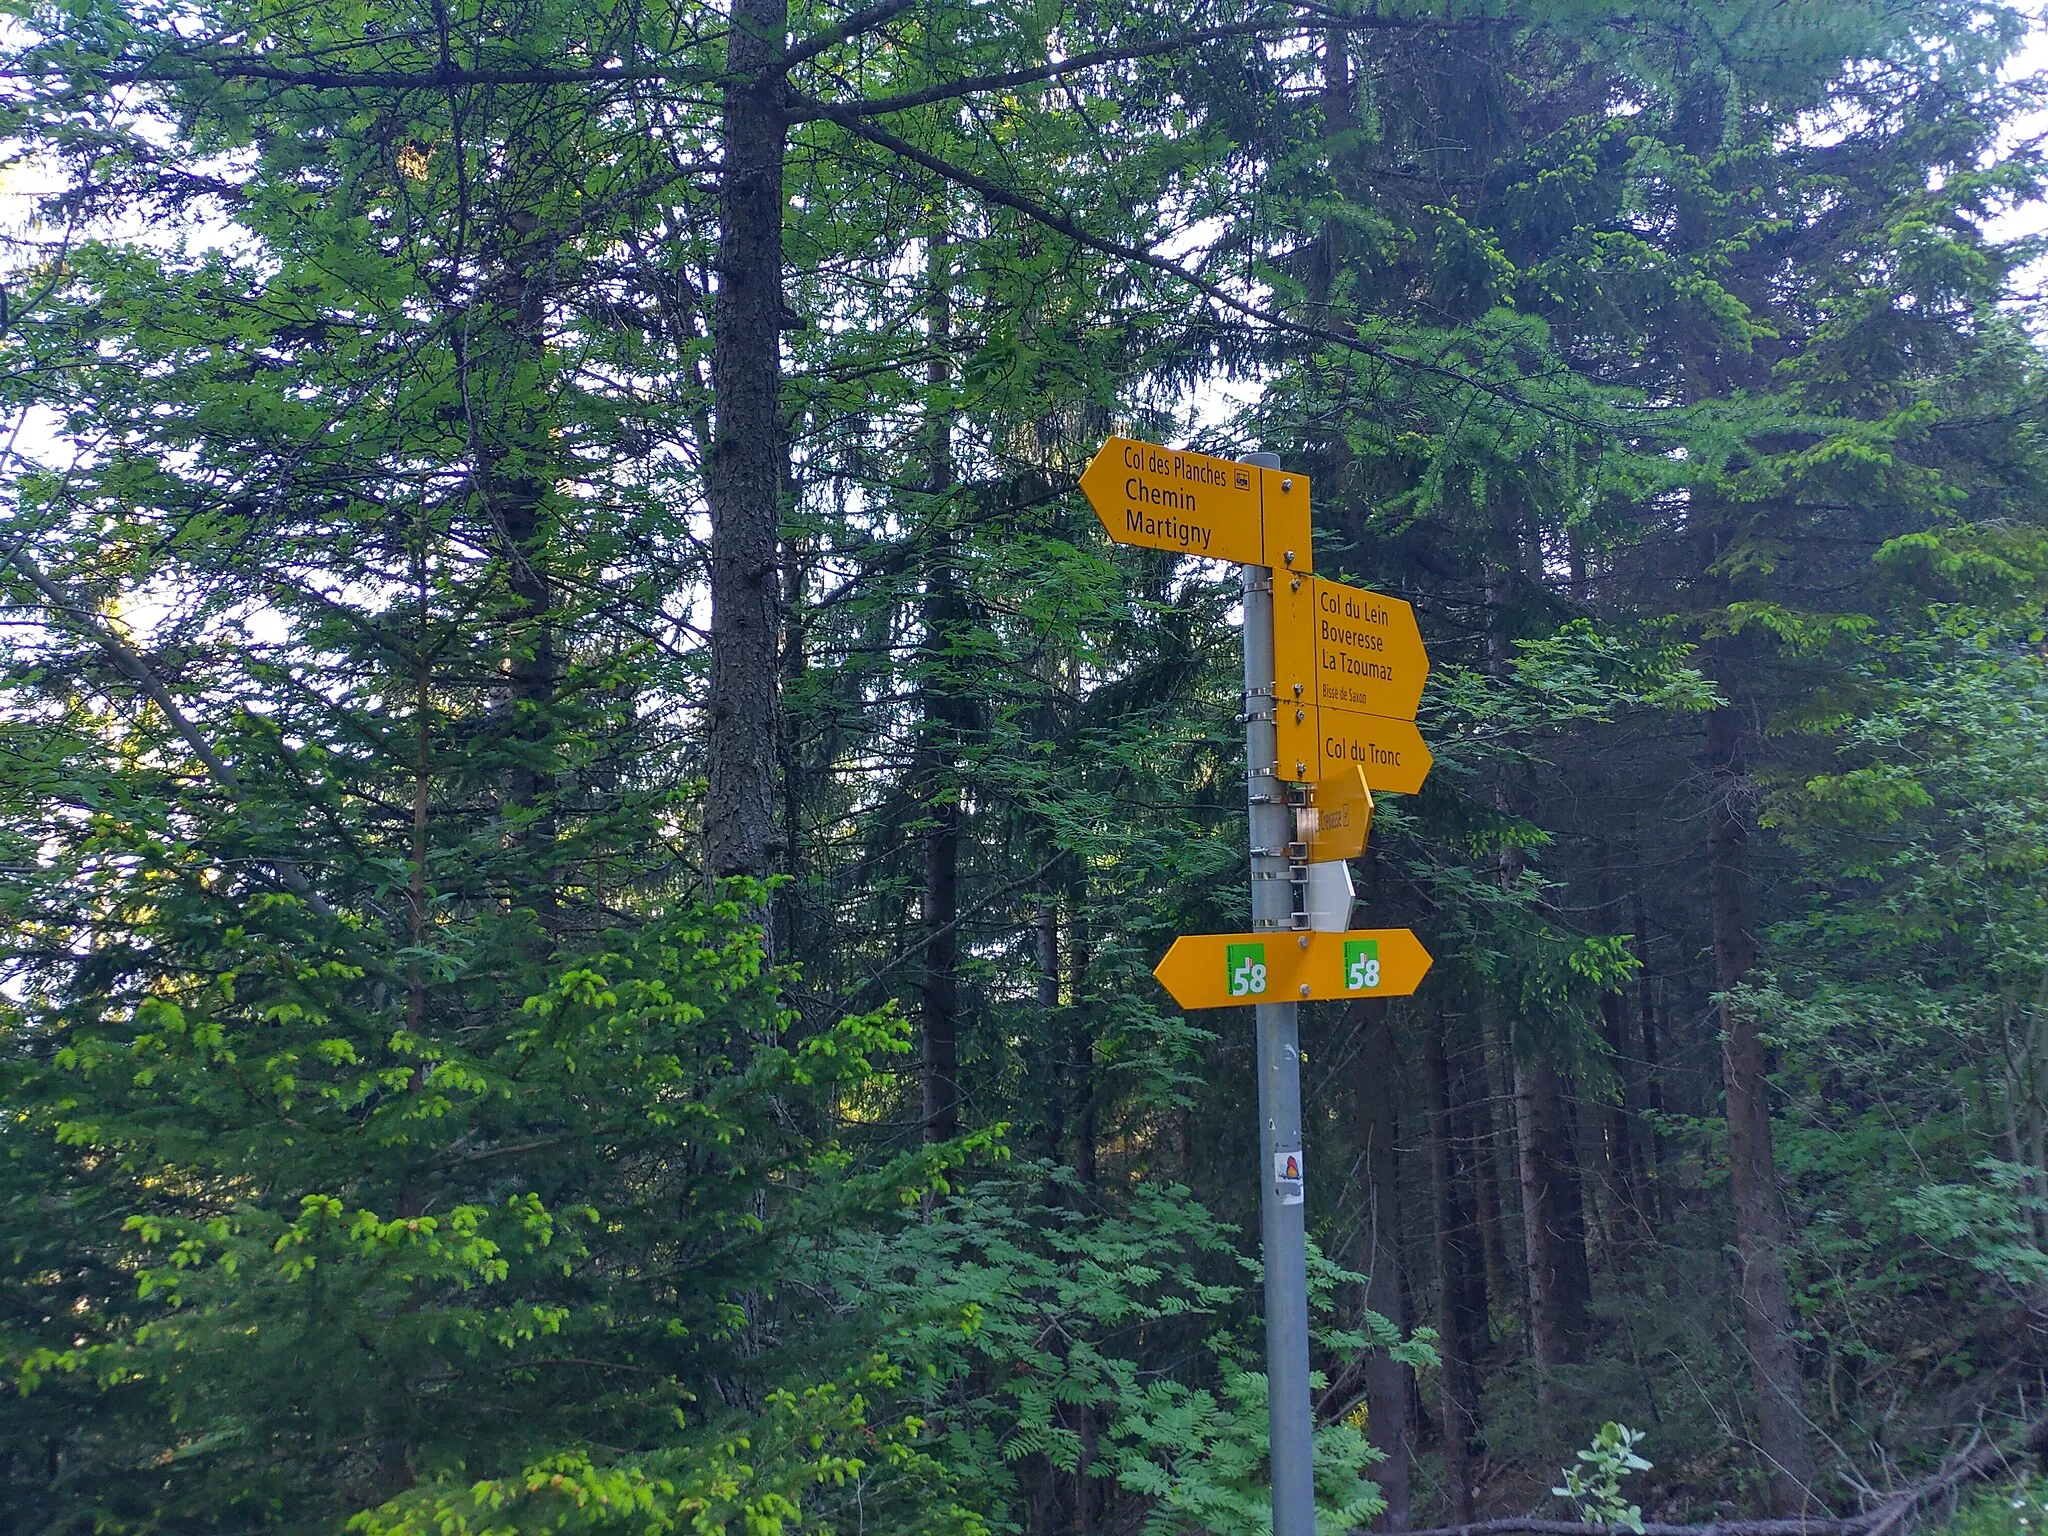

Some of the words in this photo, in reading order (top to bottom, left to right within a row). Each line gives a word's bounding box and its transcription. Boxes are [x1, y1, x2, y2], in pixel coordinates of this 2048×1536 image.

[1124, 446, 1144, 471] Col
[1149, 450, 1170, 476] des
[1174, 456, 1226, 487] Planches
[1125, 477, 1196, 511] Chemin
[1126, 509, 1211, 550] Martigny
[1320, 592, 1340, 615] Col
[1345, 597, 1360, 619] du
[1364, 602, 1389, 626] Lein
[1321, 620, 1383, 652] Boveresse
[1322, 648, 1336, 671] La
[1339, 652, 1393, 681] Tzoumaz
[1322, 684, 1338, 699] Bisse
[1340, 686, 1348, 701] de
[1348, 688, 1367, 704] Saxon
[1326, 737, 1346, 759] Col
[1350, 740, 1366, 762] du
[1369, 743, 1401, 767] Tronc
[1233, 958, 1266, 996] 58
[1349, 954, 1379, 990] 58
